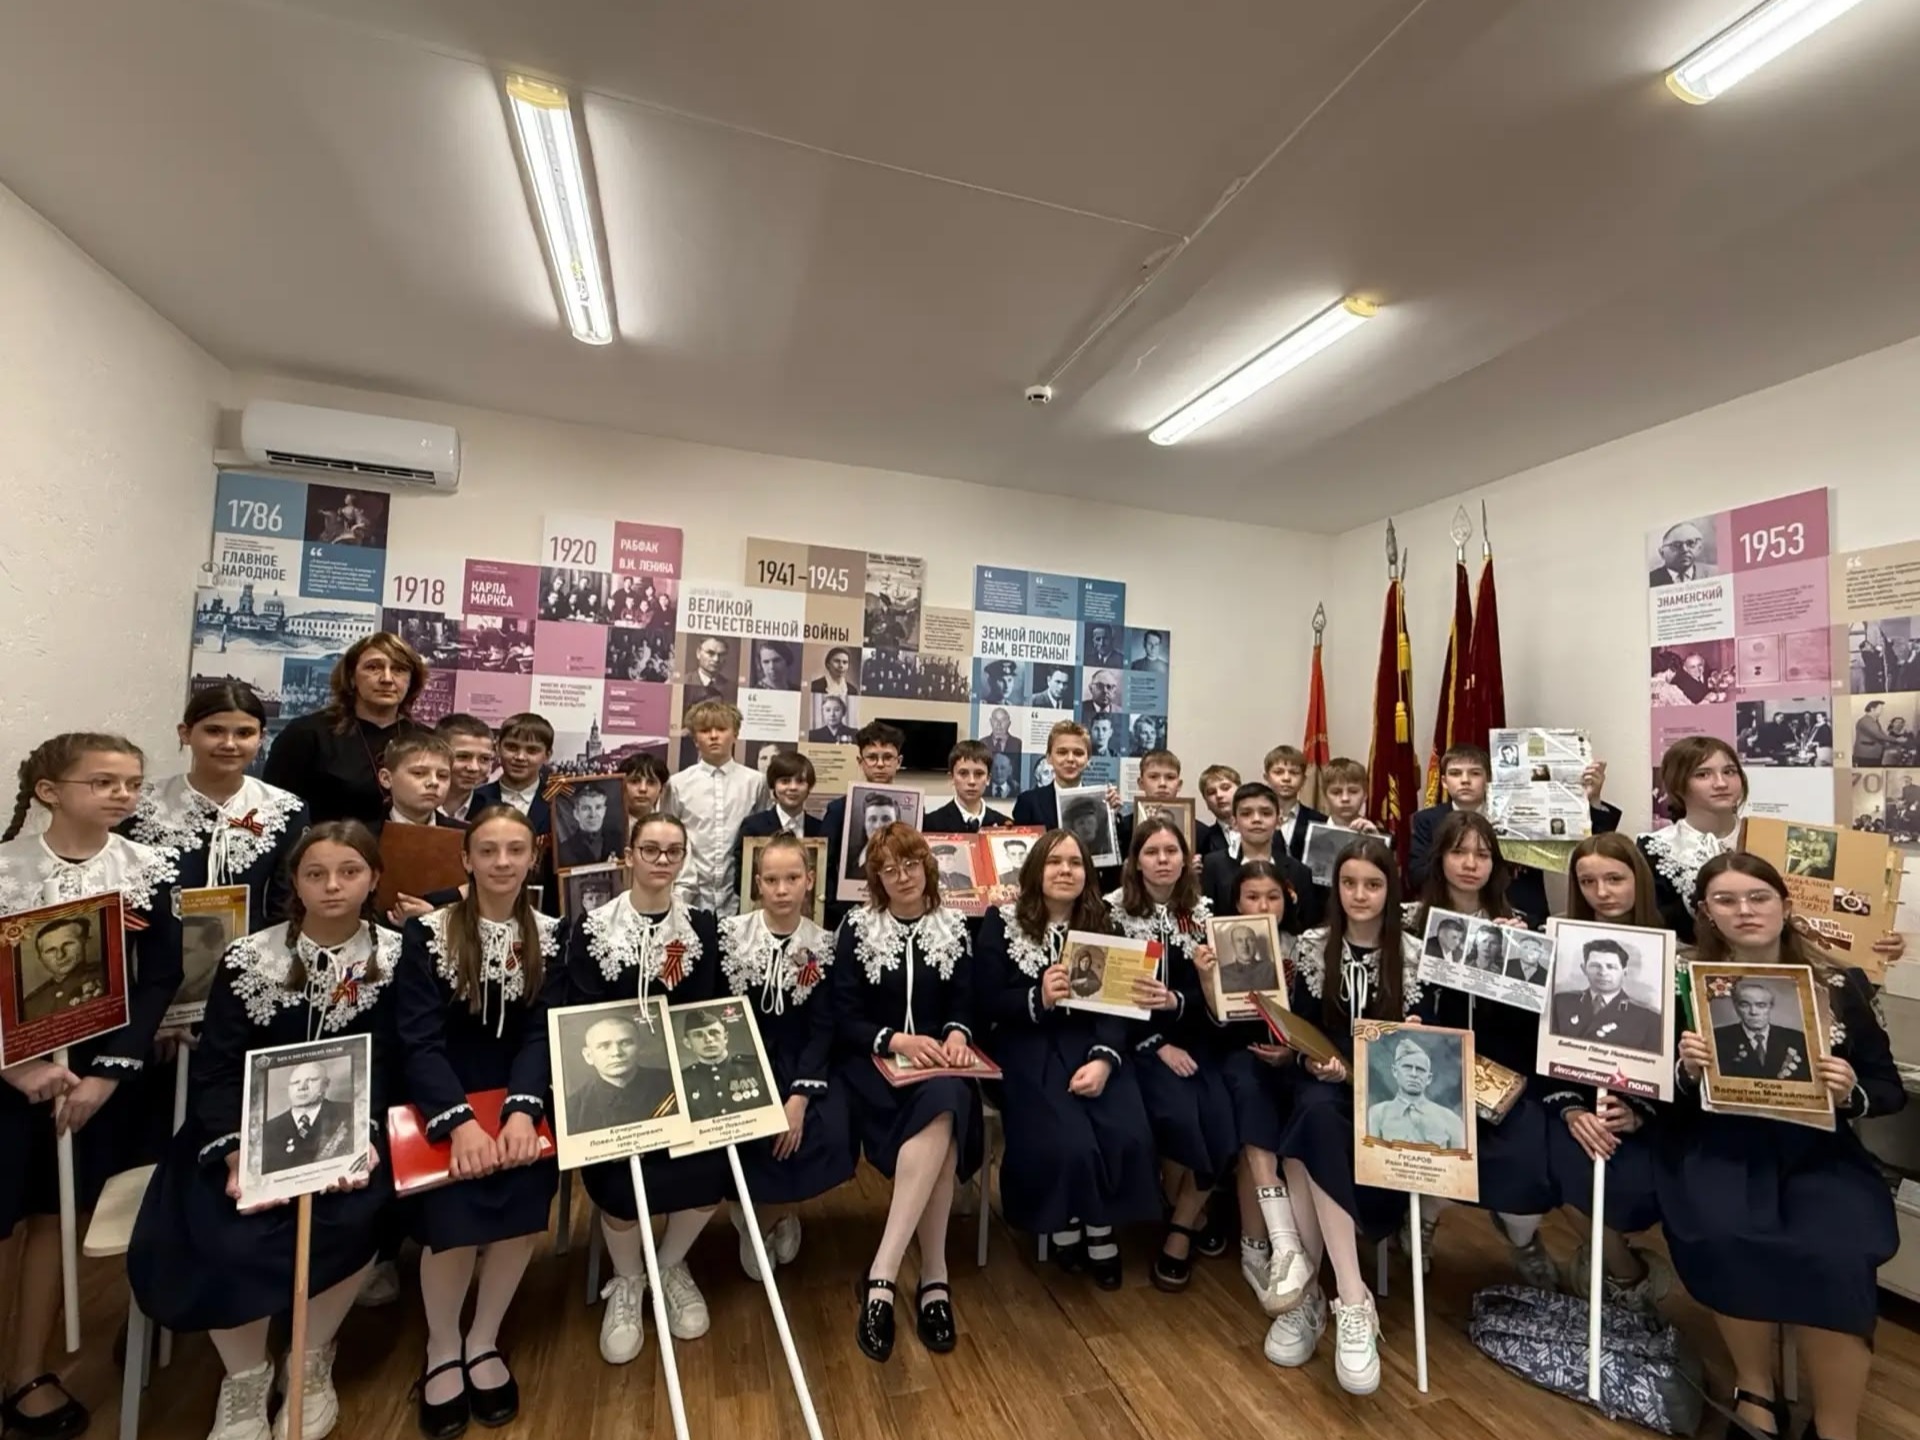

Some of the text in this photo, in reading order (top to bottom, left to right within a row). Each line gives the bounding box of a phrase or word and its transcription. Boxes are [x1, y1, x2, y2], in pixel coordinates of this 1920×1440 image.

[228, 499, 282, 532] 1786
[550, 536, 597, 565] 1920
[620, 538, 659, 553] РАБФАК
[1740, 522, 1804, 563] 1953
[222, 550, 278, 568] ГЛАВНОЕ
[639, 559, 674, 575] ЛЕНИНА
[221, 564, 287, 582] НАРОДНОЕ
[393, 575, 445, 606] 1918
[471, 580, 506, 596] КАРЛА
[1657, 585, 1723, 608] ЗНАМЕНСКИЙ
[470, 591, 514, 608] МАРКСА
[688, 596, 753, 617] ВЕЛИКОЙ
[687, 615, 849, 642] ОТЕЧЕСТВЕННОЙ ВОЙНЫ
[981, 625, 1026, 645] ЗЕМНОЙ
[1028, 630, 1071, 648] ПОКЛОН
[981, 644, 1069, 661] ВАМ, ВЕТЕРАНЫ!
[1754, 1081, 1783, 1090] Юсов
[1398, 1154, 1432, 1164] ГУСАРОВ
